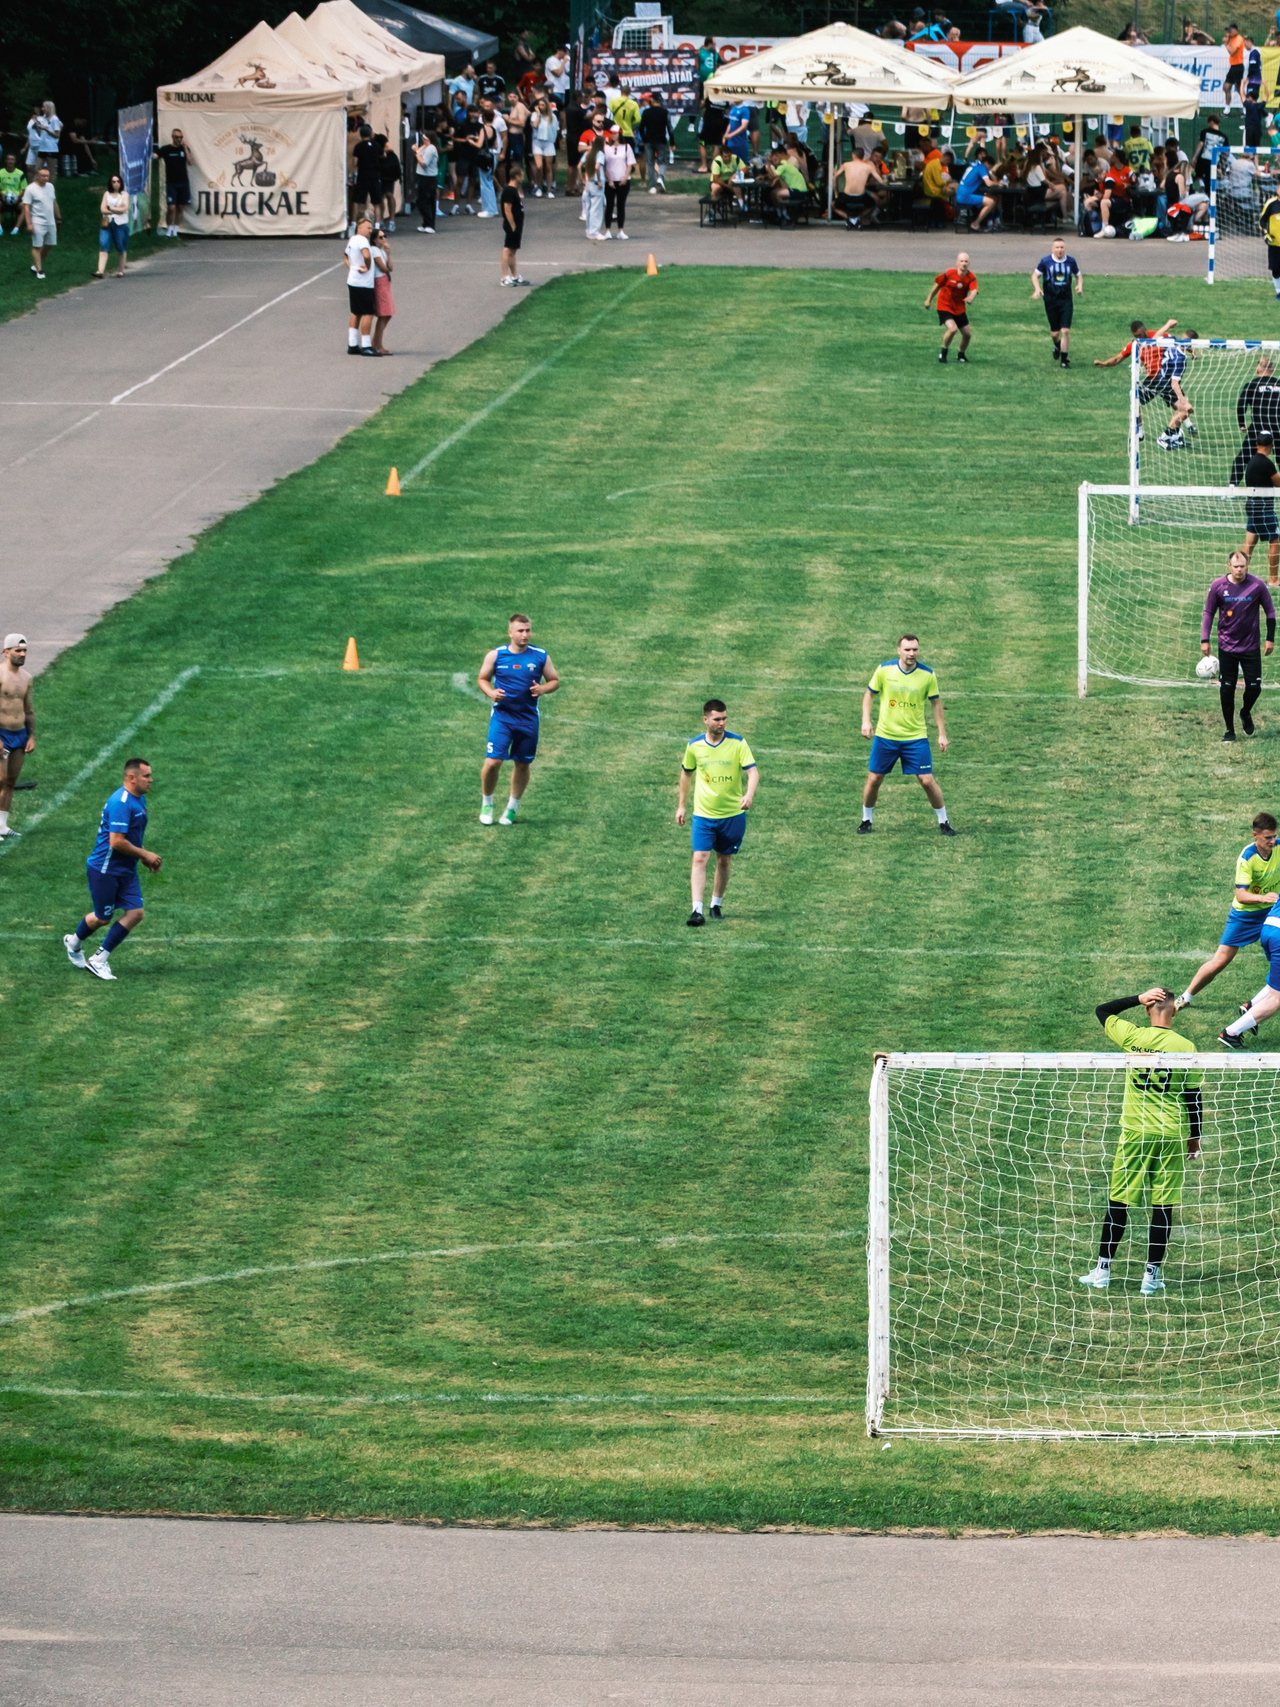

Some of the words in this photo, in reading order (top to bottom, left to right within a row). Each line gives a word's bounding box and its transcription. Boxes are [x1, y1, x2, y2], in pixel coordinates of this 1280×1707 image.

[670, 71, 693, 83] ЭТАП
[173, 92, 217, 103] ЛІДСКАЕ
[1128, 150, 1149, 165] 67
[194, 190, 310, 219] ЛІДСКАЕ
